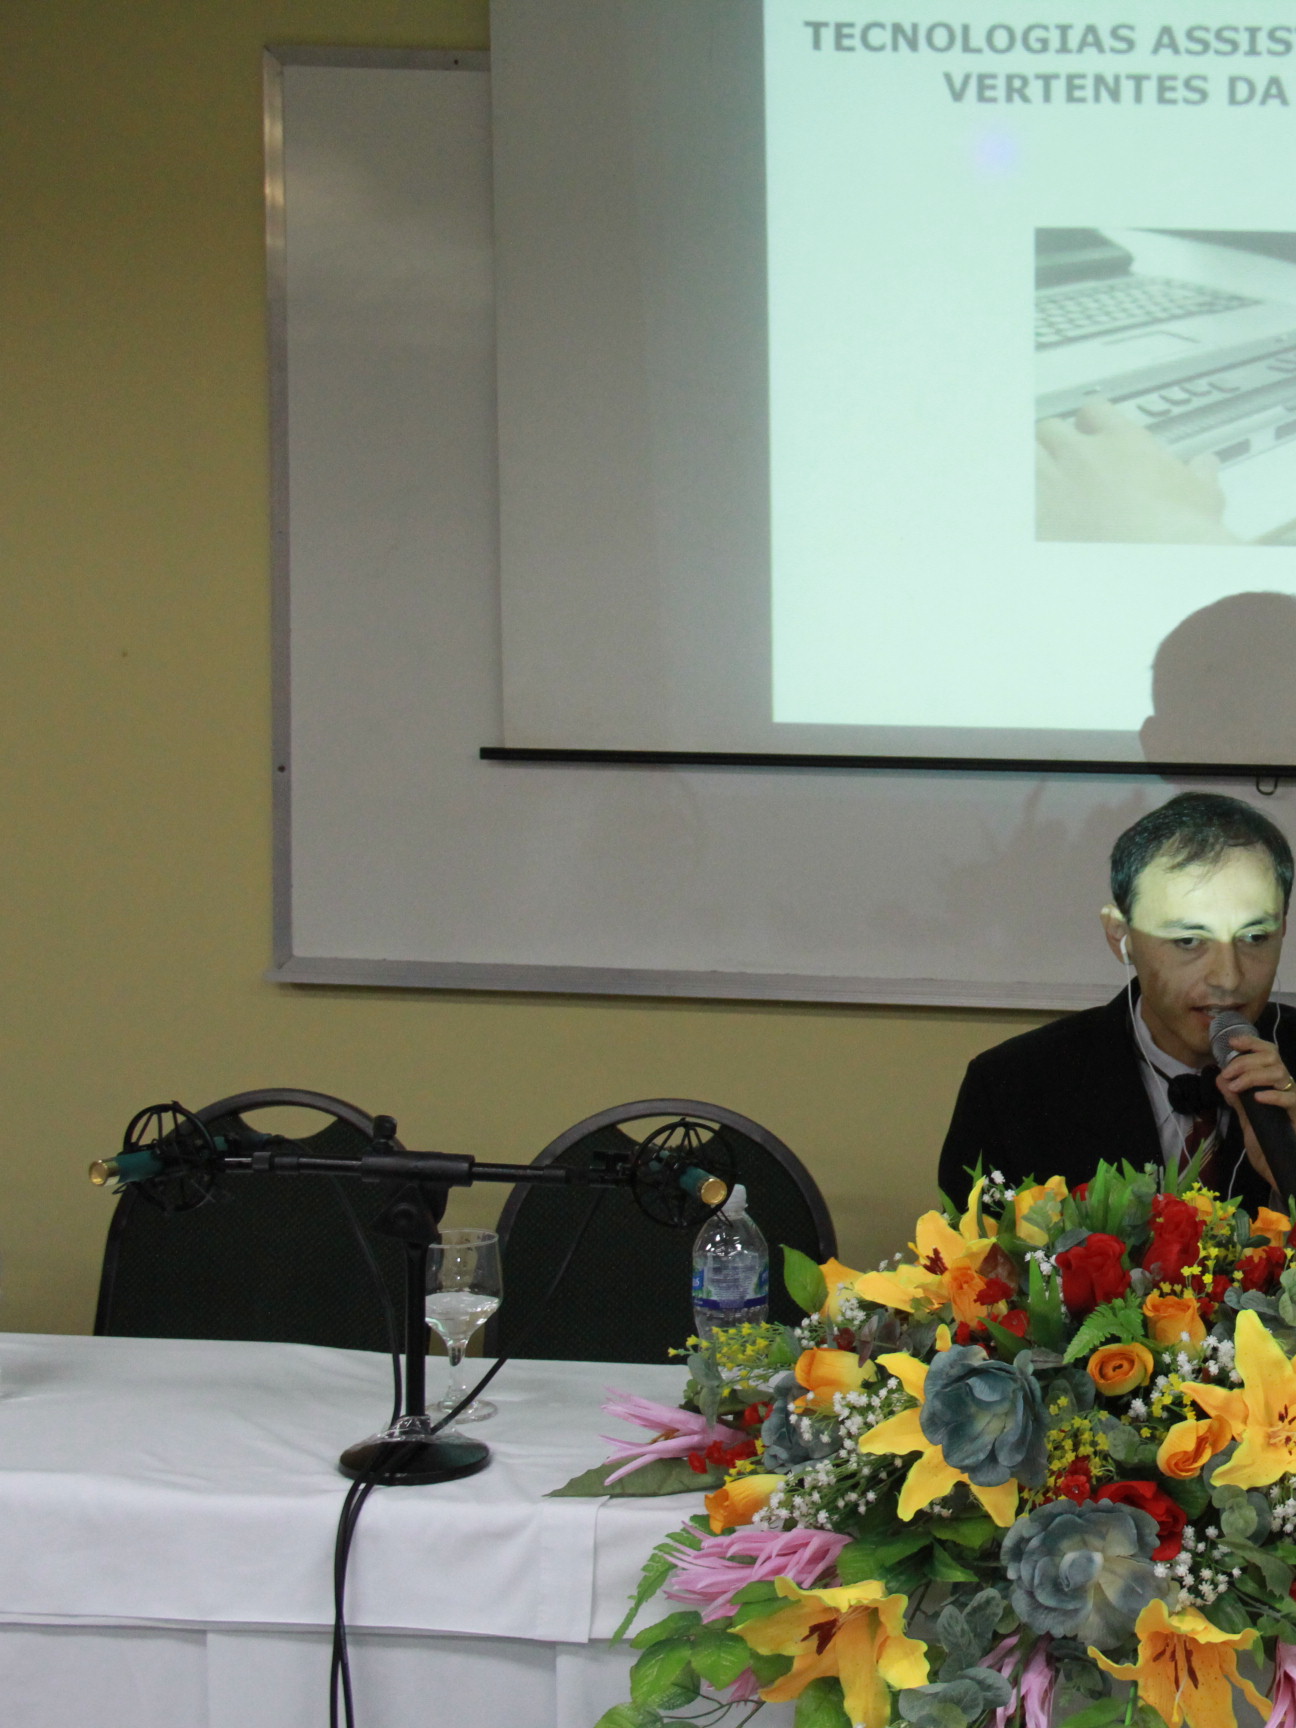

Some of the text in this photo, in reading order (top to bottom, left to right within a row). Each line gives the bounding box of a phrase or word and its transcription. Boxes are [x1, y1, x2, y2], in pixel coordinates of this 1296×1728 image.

[803, 20, 1136, 55] TECNOLOGIAS
[942, 71, 1210, 106] VERTENTES
[1227, 75, 1290, 107] DA
